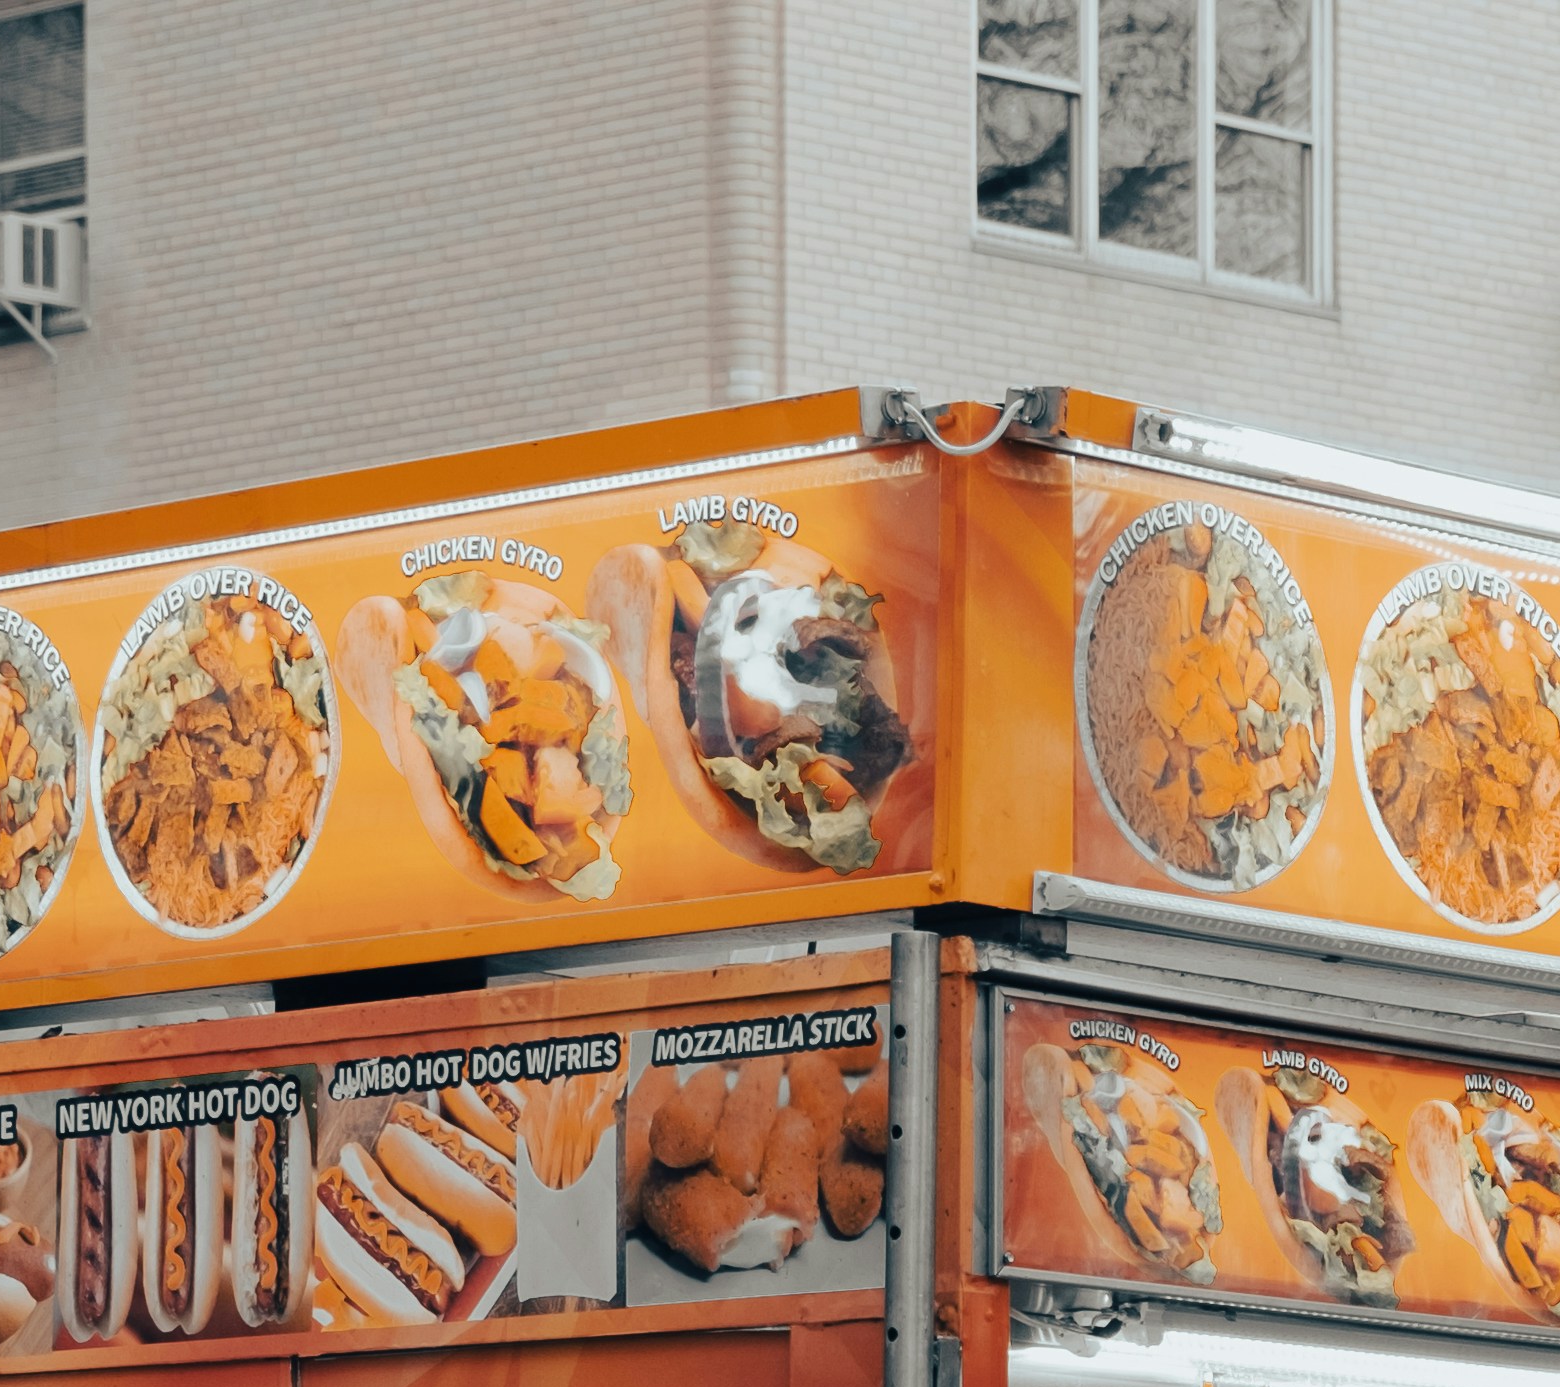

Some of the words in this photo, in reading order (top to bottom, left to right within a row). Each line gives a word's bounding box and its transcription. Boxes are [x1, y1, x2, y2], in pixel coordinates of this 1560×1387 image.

[658, 495, 726, 533] LAMB
[731, 496, 799, 538] GYRO
[1378, 565, 1442, 626] LAMB
[1446, 565, 1511, 606] OVER
[655, 1016, 804, 1062] MOZZARELLA
[807, 1011, 873, 1047] STICK
[1261, 1048, 1307, 1072] LAMB
[1306, 1057, 1350, 1094] GYRO
[59, 1100, 115, 1134] NEW
[115, 1094, 183, 1129] YORK
[187, 1088, 238, 1122] HOT
[243, 1081, 298, 1116] DOG
